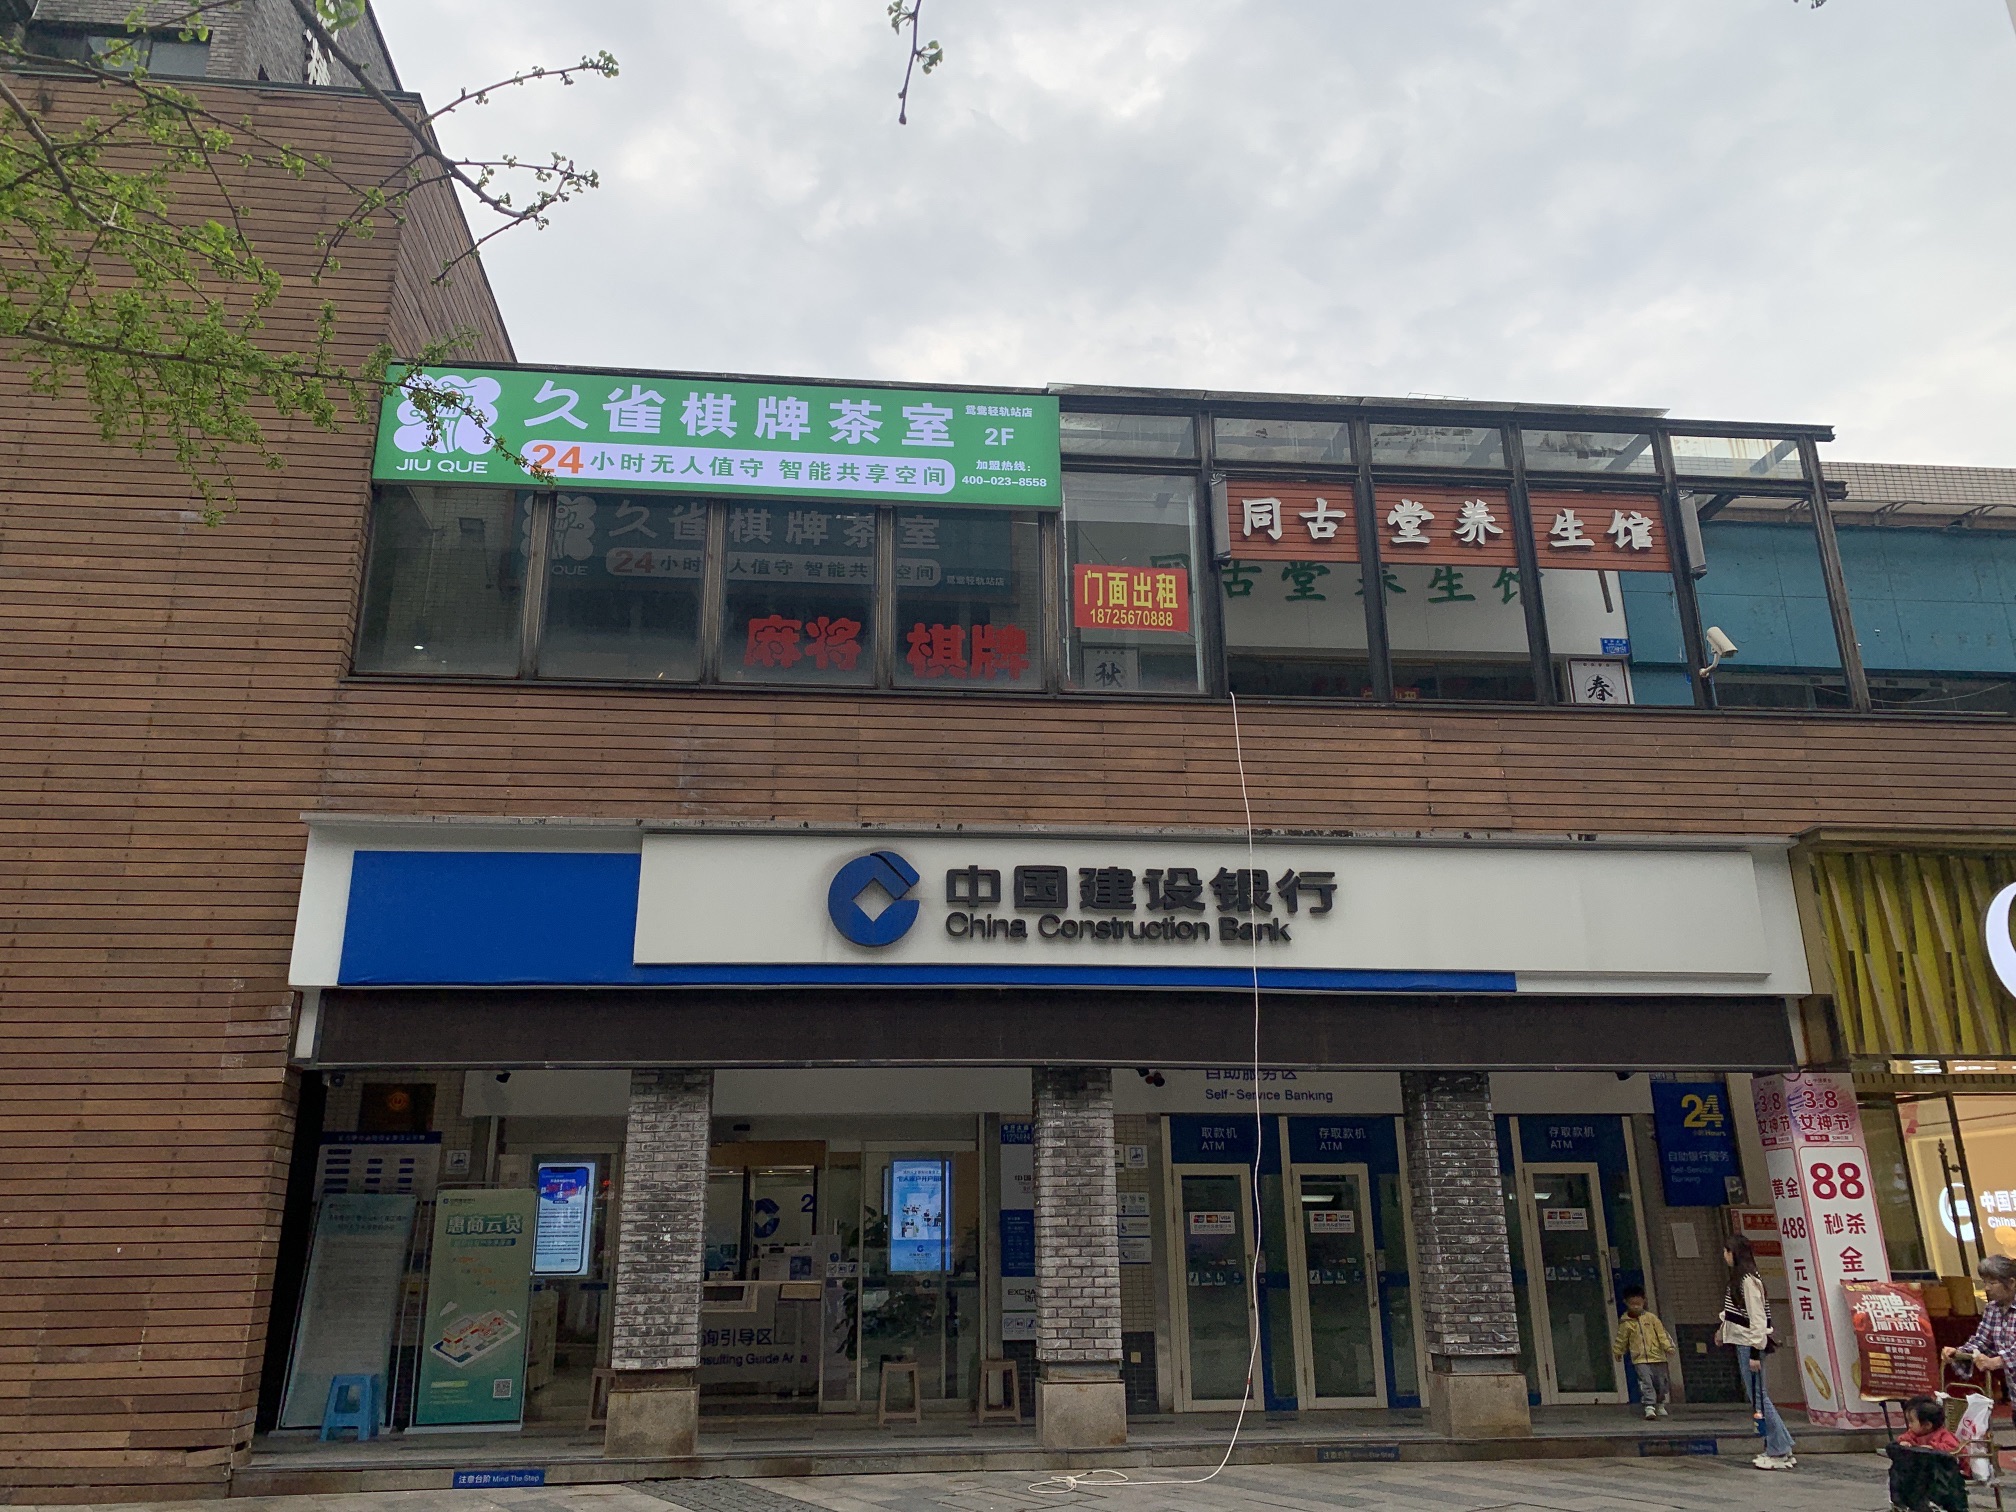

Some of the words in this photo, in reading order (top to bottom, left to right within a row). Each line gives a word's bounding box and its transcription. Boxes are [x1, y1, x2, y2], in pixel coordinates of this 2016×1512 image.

[523, 379, 955, 447] 久雀棋牌茶室
[965, 404, 1033, 418] 鸳鸯轻轨站店
[984, 428, 1014, 446] 2F
[396, 458, 431, 473] JIU
[437, 459, 488, 474] QUE
[530, 443, 764, 478] 24小时无人值守
[779, 458, 946, 487] 智能共享空间
[961, 475, 1048, 488] 400-023-8558
[1242, 496, 1654, 552] 同古堂养生馆
[1084, 569, 1179, 609] 门面出租
[1090, 608, 1173, 627] 18725670888
[742, 614, 862, 670] 麻将
[907, 622, 1030, 680] 棋牌
[1587, 675, 1613, 702] 春
[946, 864, 1338, 915] 中国建设银行
[945, 911, 1029, 939] China
[1037, 913, 1211, 942] Construction
[1219, 917, 1292, 944] Bank
[1285, 1090, 1333, 1102] Banking
[1759, 1092, 1781, 1113] 3.8
[1802, 1090, 1838, 1109] 3.8
[1681, 1093, 1725, 1128] 24
[1548, 1125, 1595, 1138] 存取款机
[1758, 1114, 1790, 1135] 女神节
[1799, 1113, 1850, 1131] 女神节
[1201, 1126, 1238, 1140] 取款机
[1319, 1126, 1367, 1140] 存取款机
[1201, 1141, 1225, 1151] ATM
[1319, 1141, 1343, 1151] ATM
[1549, 1139, 1573, 1149] ATM
[1668, 1150, 1730, 1163] 自助银行服务
[1771, 1176, 1800, 1199] 黄金
[1810, 1162, 1865, 1200] 88
[446, 1214, 523, 1234] 惠商云贷
[1782, 1216, 1806, 1239] 488
[1823, 1212, 1867, 1235] 秒杀
[1839, 1246, 1865, 1272] 金
[745, 1353, 779, 1364] Guide
[782, 1353, 808, 1363] Ara
[458, 1475, 491, 1484] 注意台阶
[492, 1475, 509, 1483] Mind
[524, 1474, 540, 1483] Step
